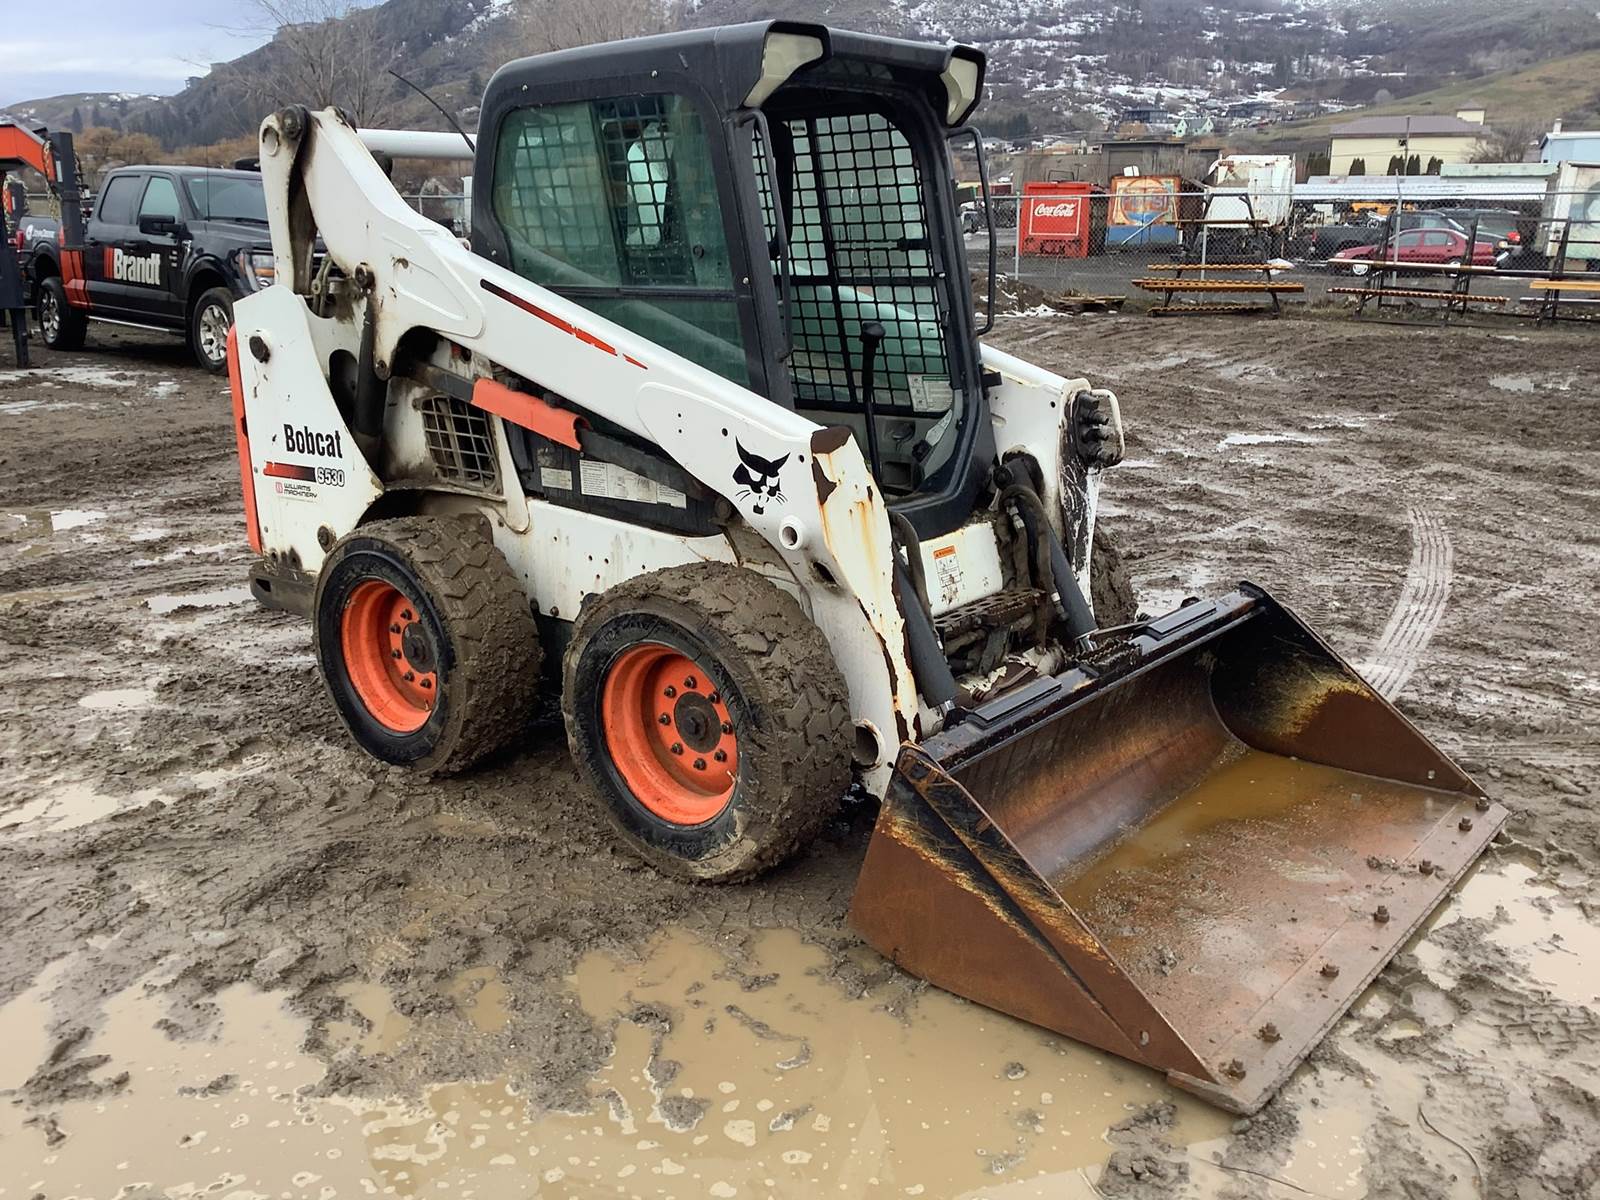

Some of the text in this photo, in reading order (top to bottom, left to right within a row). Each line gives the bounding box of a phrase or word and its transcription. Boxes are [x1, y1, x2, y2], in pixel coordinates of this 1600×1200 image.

[113, 248, 161, 285] Brandt
[283, 423, 343, 459] Bobcat
[283, 482, 312, 492] WILLIAMS
[317, 467, 345, 488] S530
[283, 489, 318, 498] MACHINERY
